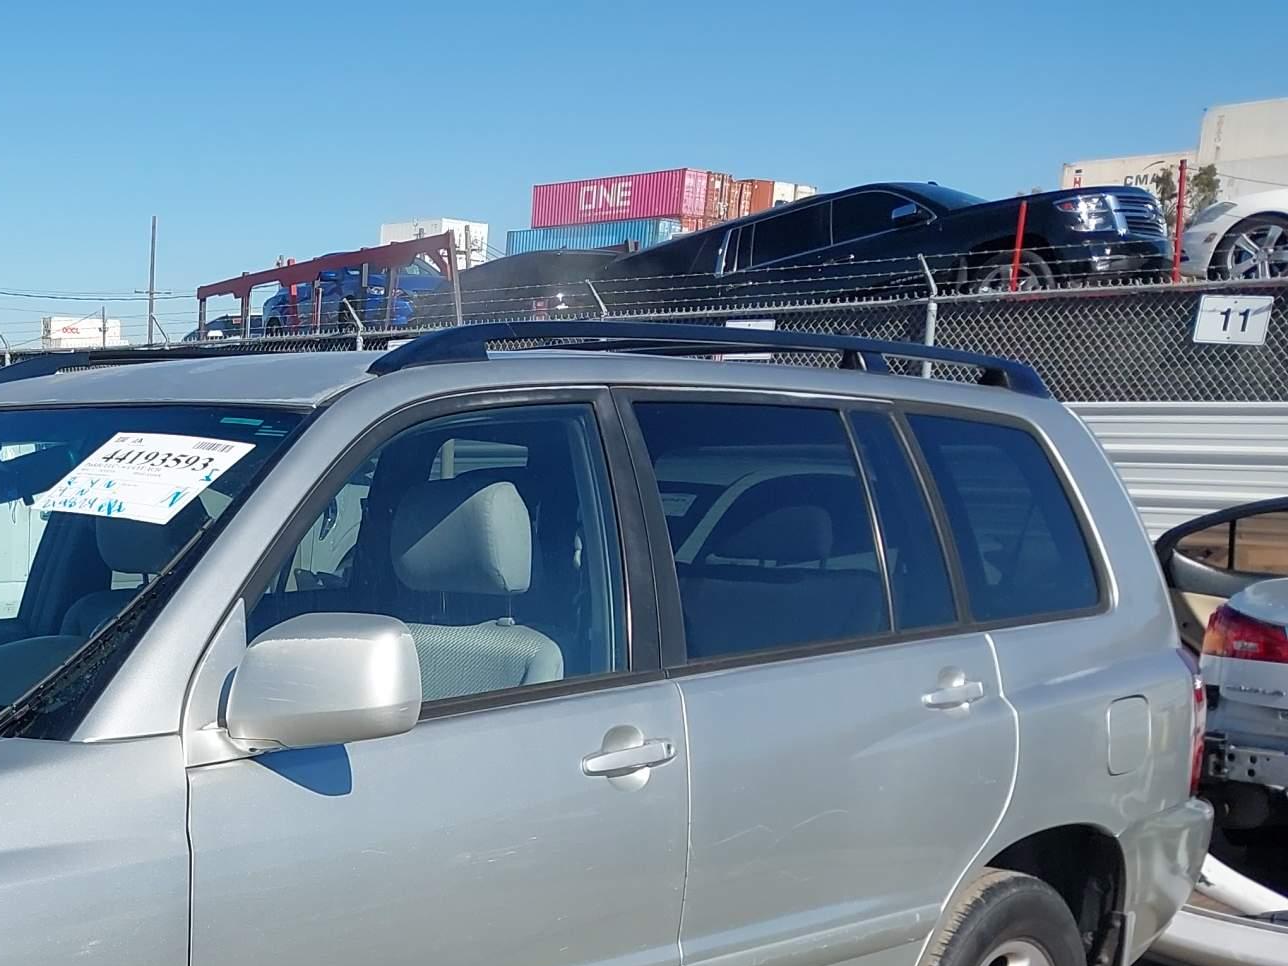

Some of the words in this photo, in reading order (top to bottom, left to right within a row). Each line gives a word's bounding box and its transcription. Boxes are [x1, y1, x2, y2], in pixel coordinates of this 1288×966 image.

[579, 181, 632, 211] ONE
[1220, 307, 1253, 333] 11
[101, 448, 214, 471] 44193593
